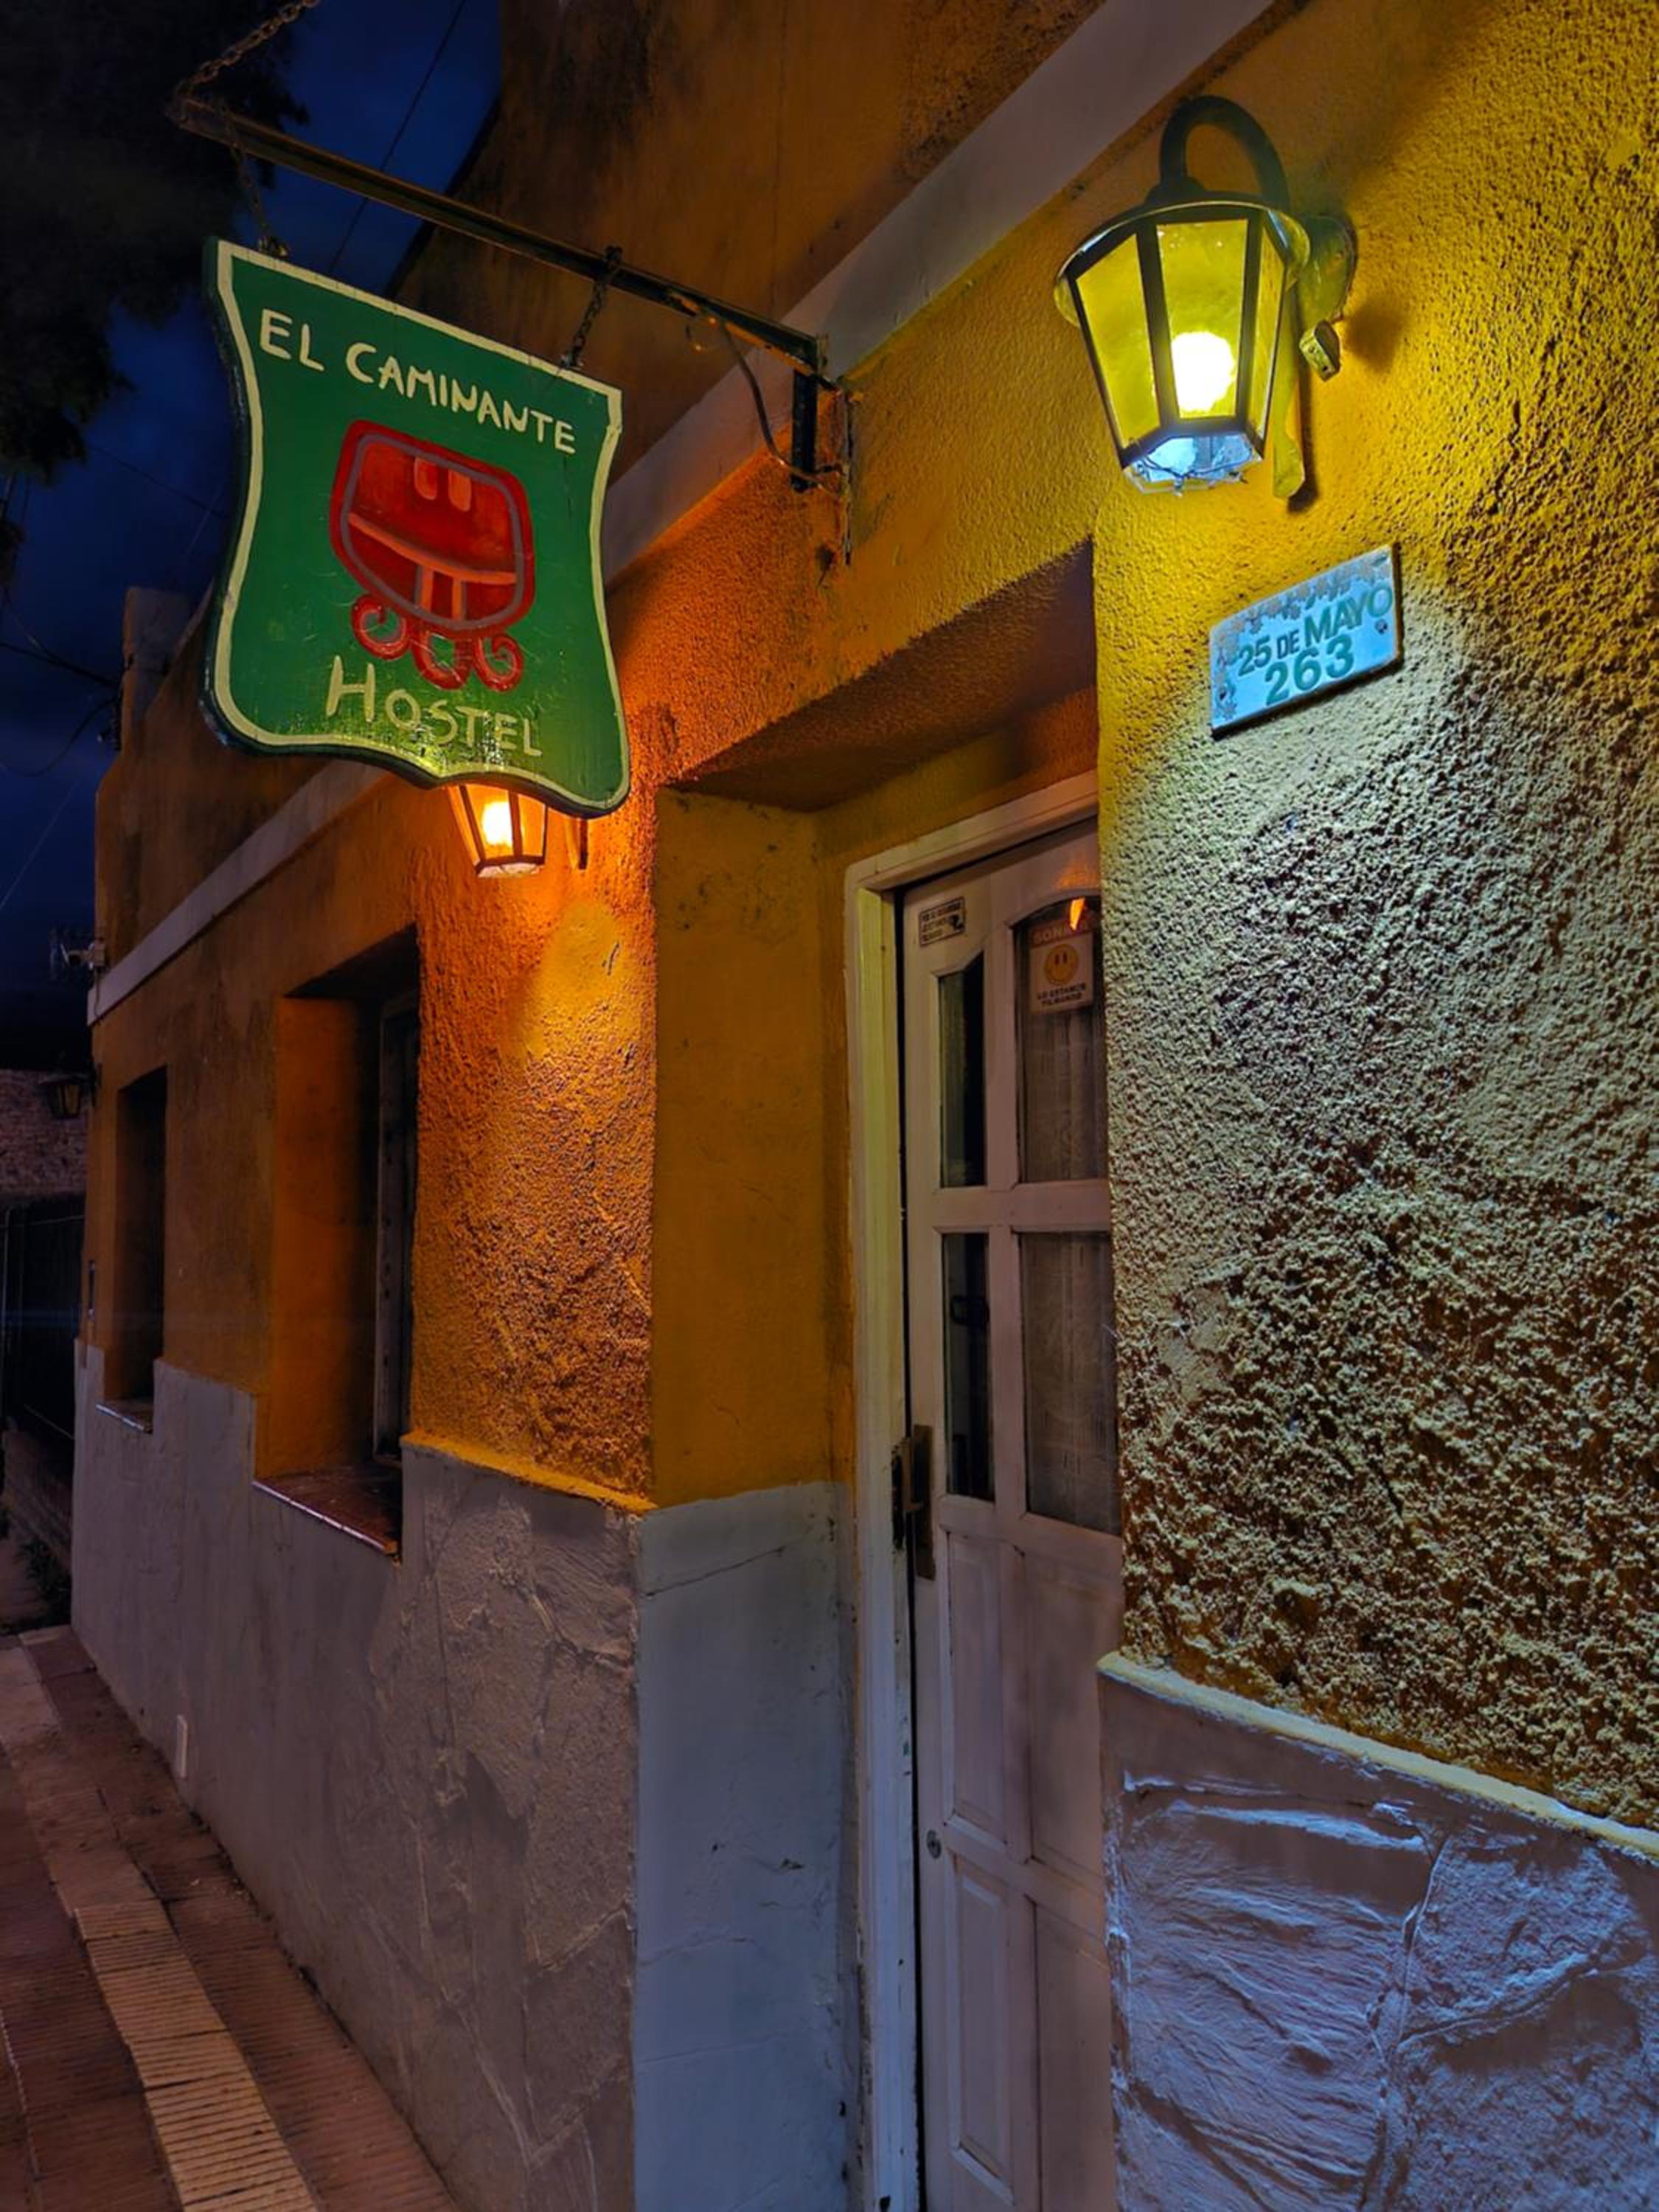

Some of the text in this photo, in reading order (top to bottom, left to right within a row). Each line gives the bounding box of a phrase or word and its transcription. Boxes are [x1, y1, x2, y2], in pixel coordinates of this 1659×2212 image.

[260, 308, 576, 454] EL CAMINANTE
[1238, 584, 1393, 676] 25 DE MAYO
[1265, 634, 1354, 706] 263
[325, 655, 543, 757] HOSTEL
